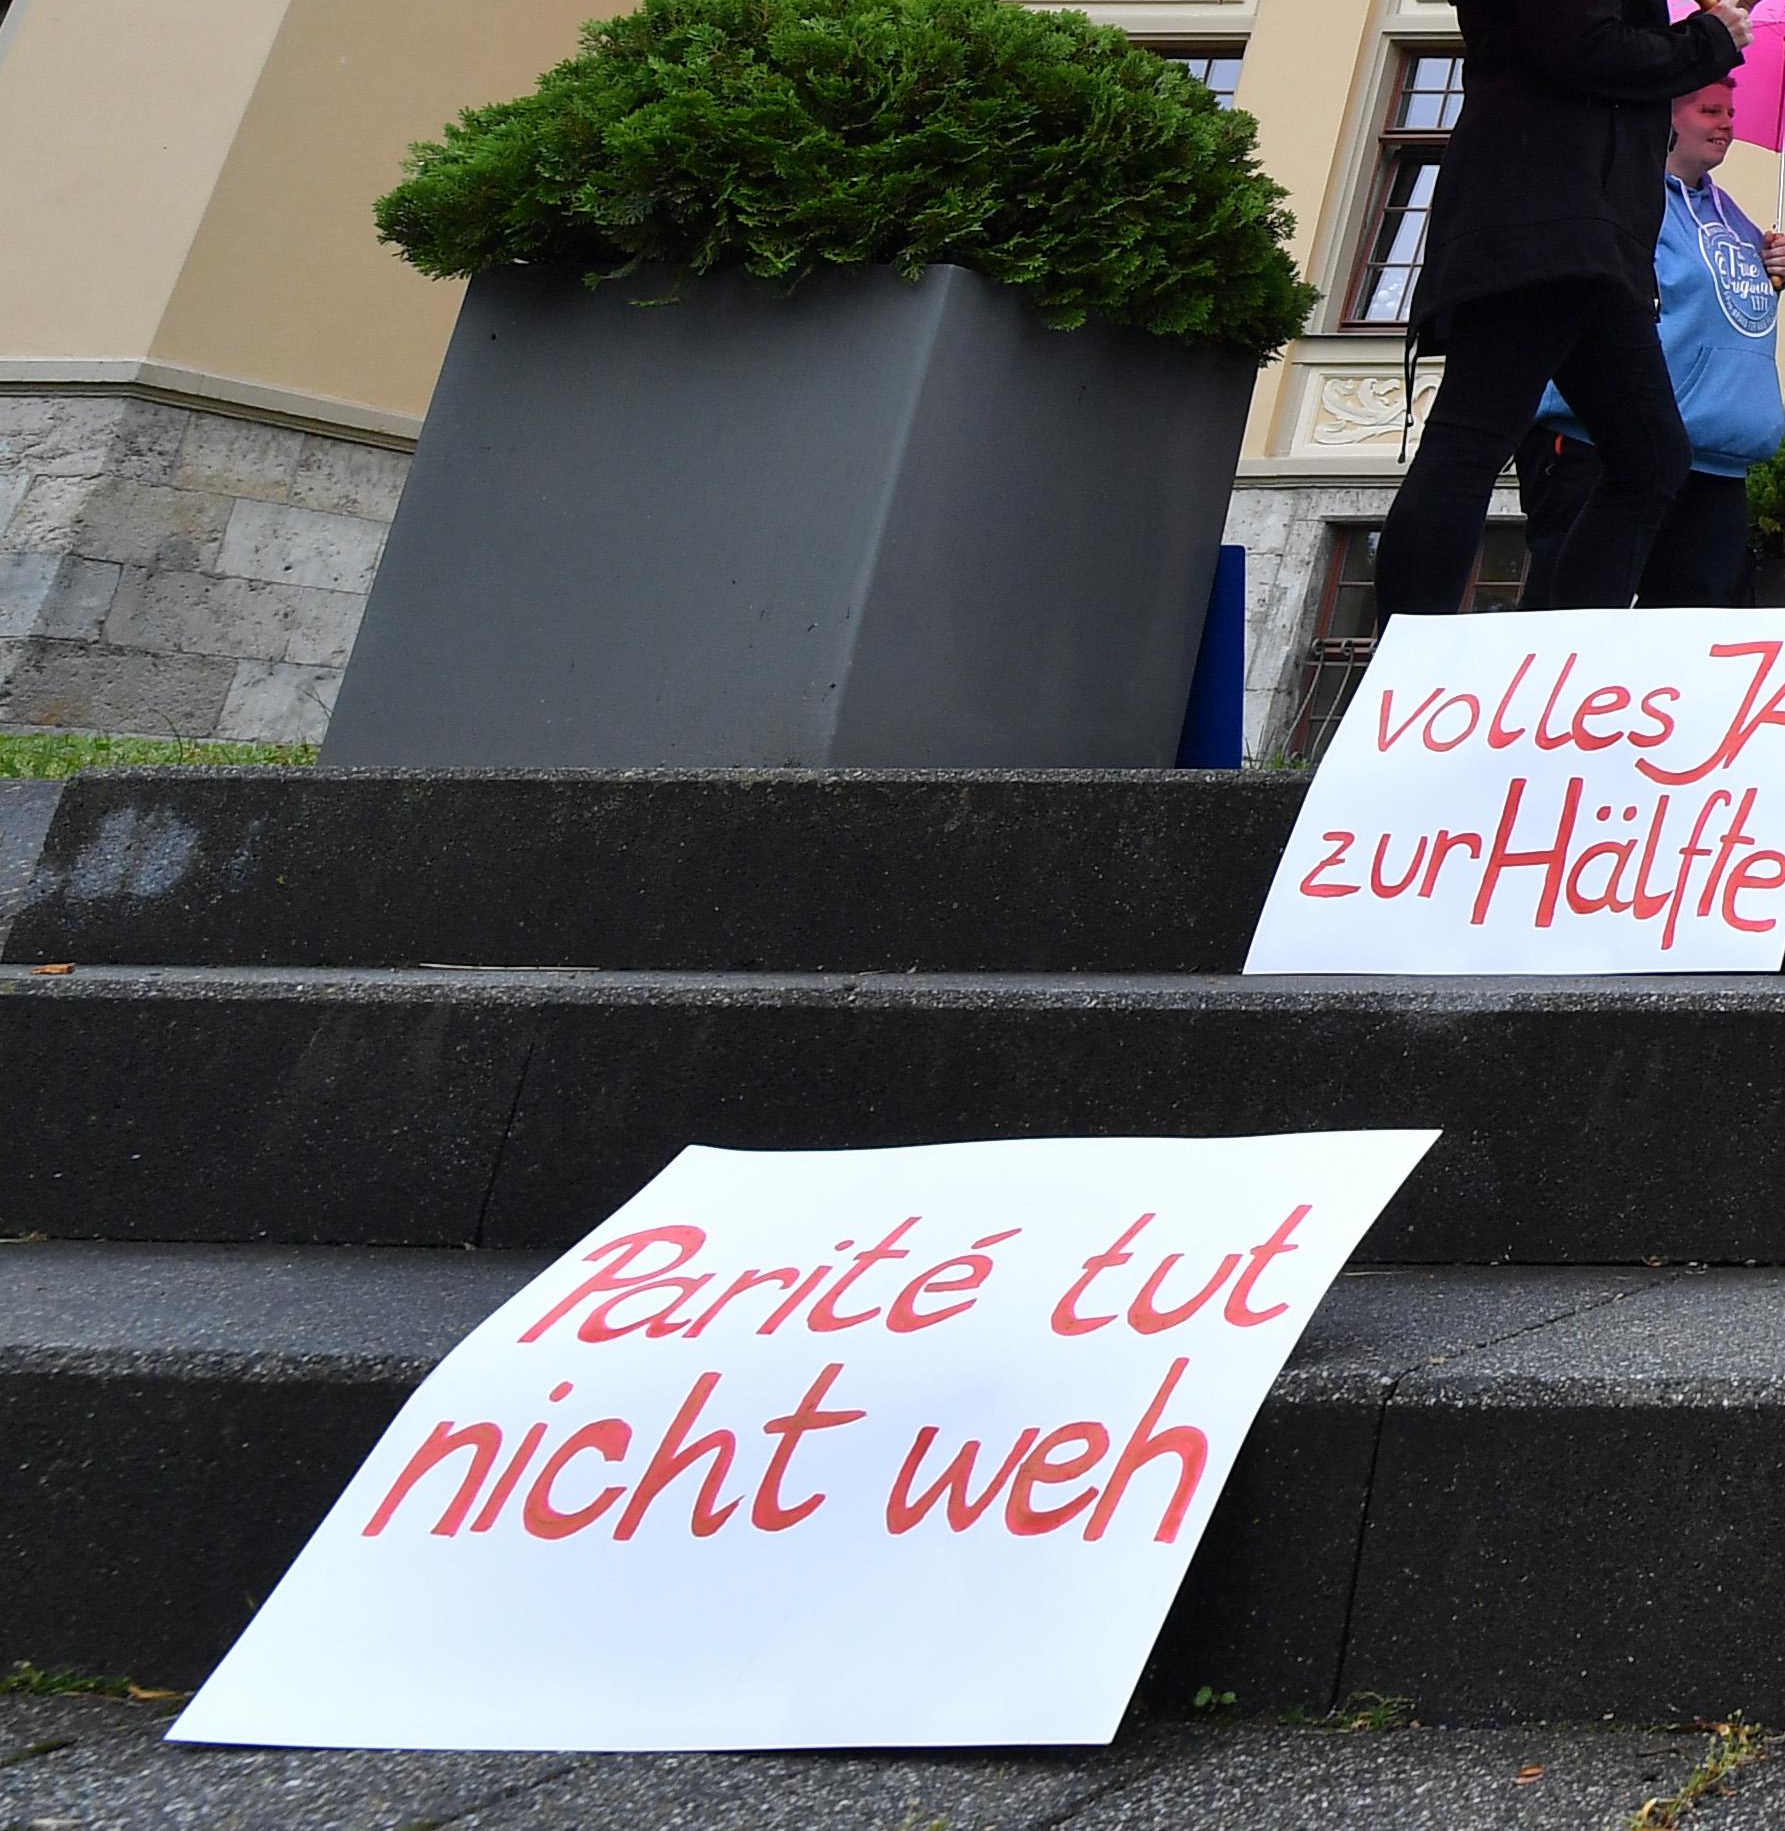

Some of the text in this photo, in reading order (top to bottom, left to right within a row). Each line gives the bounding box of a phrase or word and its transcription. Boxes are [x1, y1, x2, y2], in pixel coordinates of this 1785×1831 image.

[1378, 653, 1681, 752] volles
[518, 1204, 1311, 1344] Parité tut
[362, 1357, 1210, 1544] nicht weh
